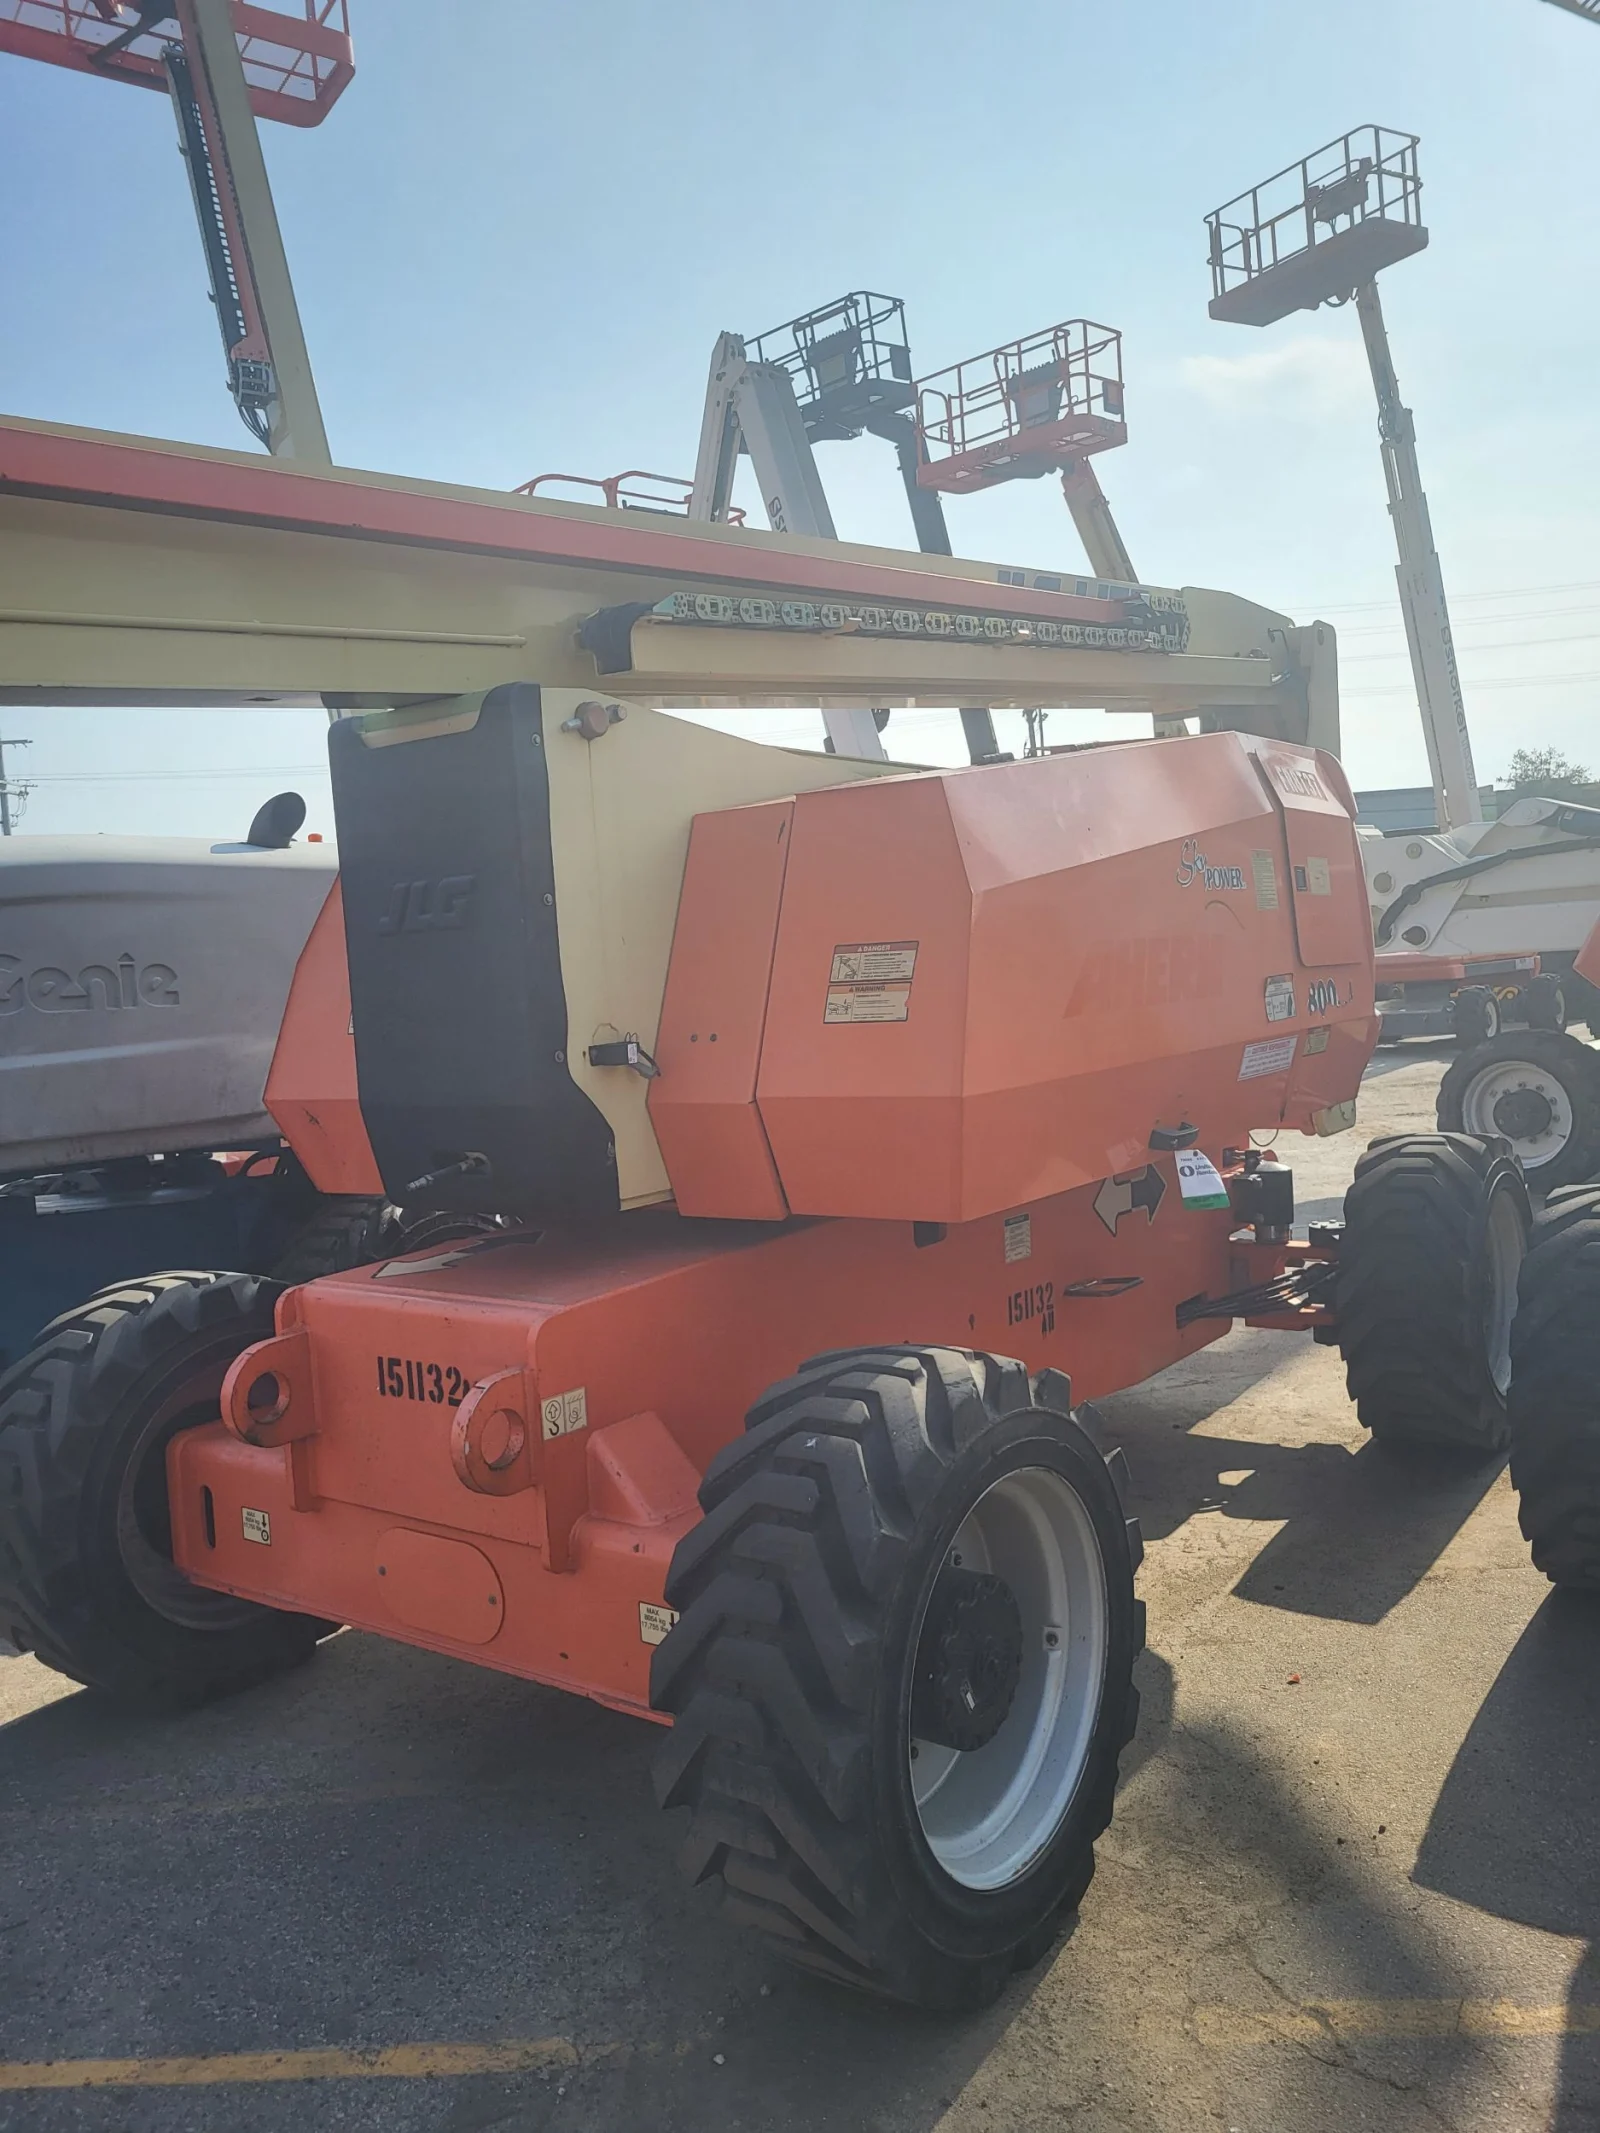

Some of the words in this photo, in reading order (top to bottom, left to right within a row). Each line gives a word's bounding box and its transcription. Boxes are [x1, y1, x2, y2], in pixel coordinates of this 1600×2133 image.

[1205, 867, 1242, 890] POWER
[379, 874, 476, 937] JLG
[855, 985, 886, 993] WARNING
[646, 1607, 660, 1616] MAX
[659, 1618, 667, 1627] kg
